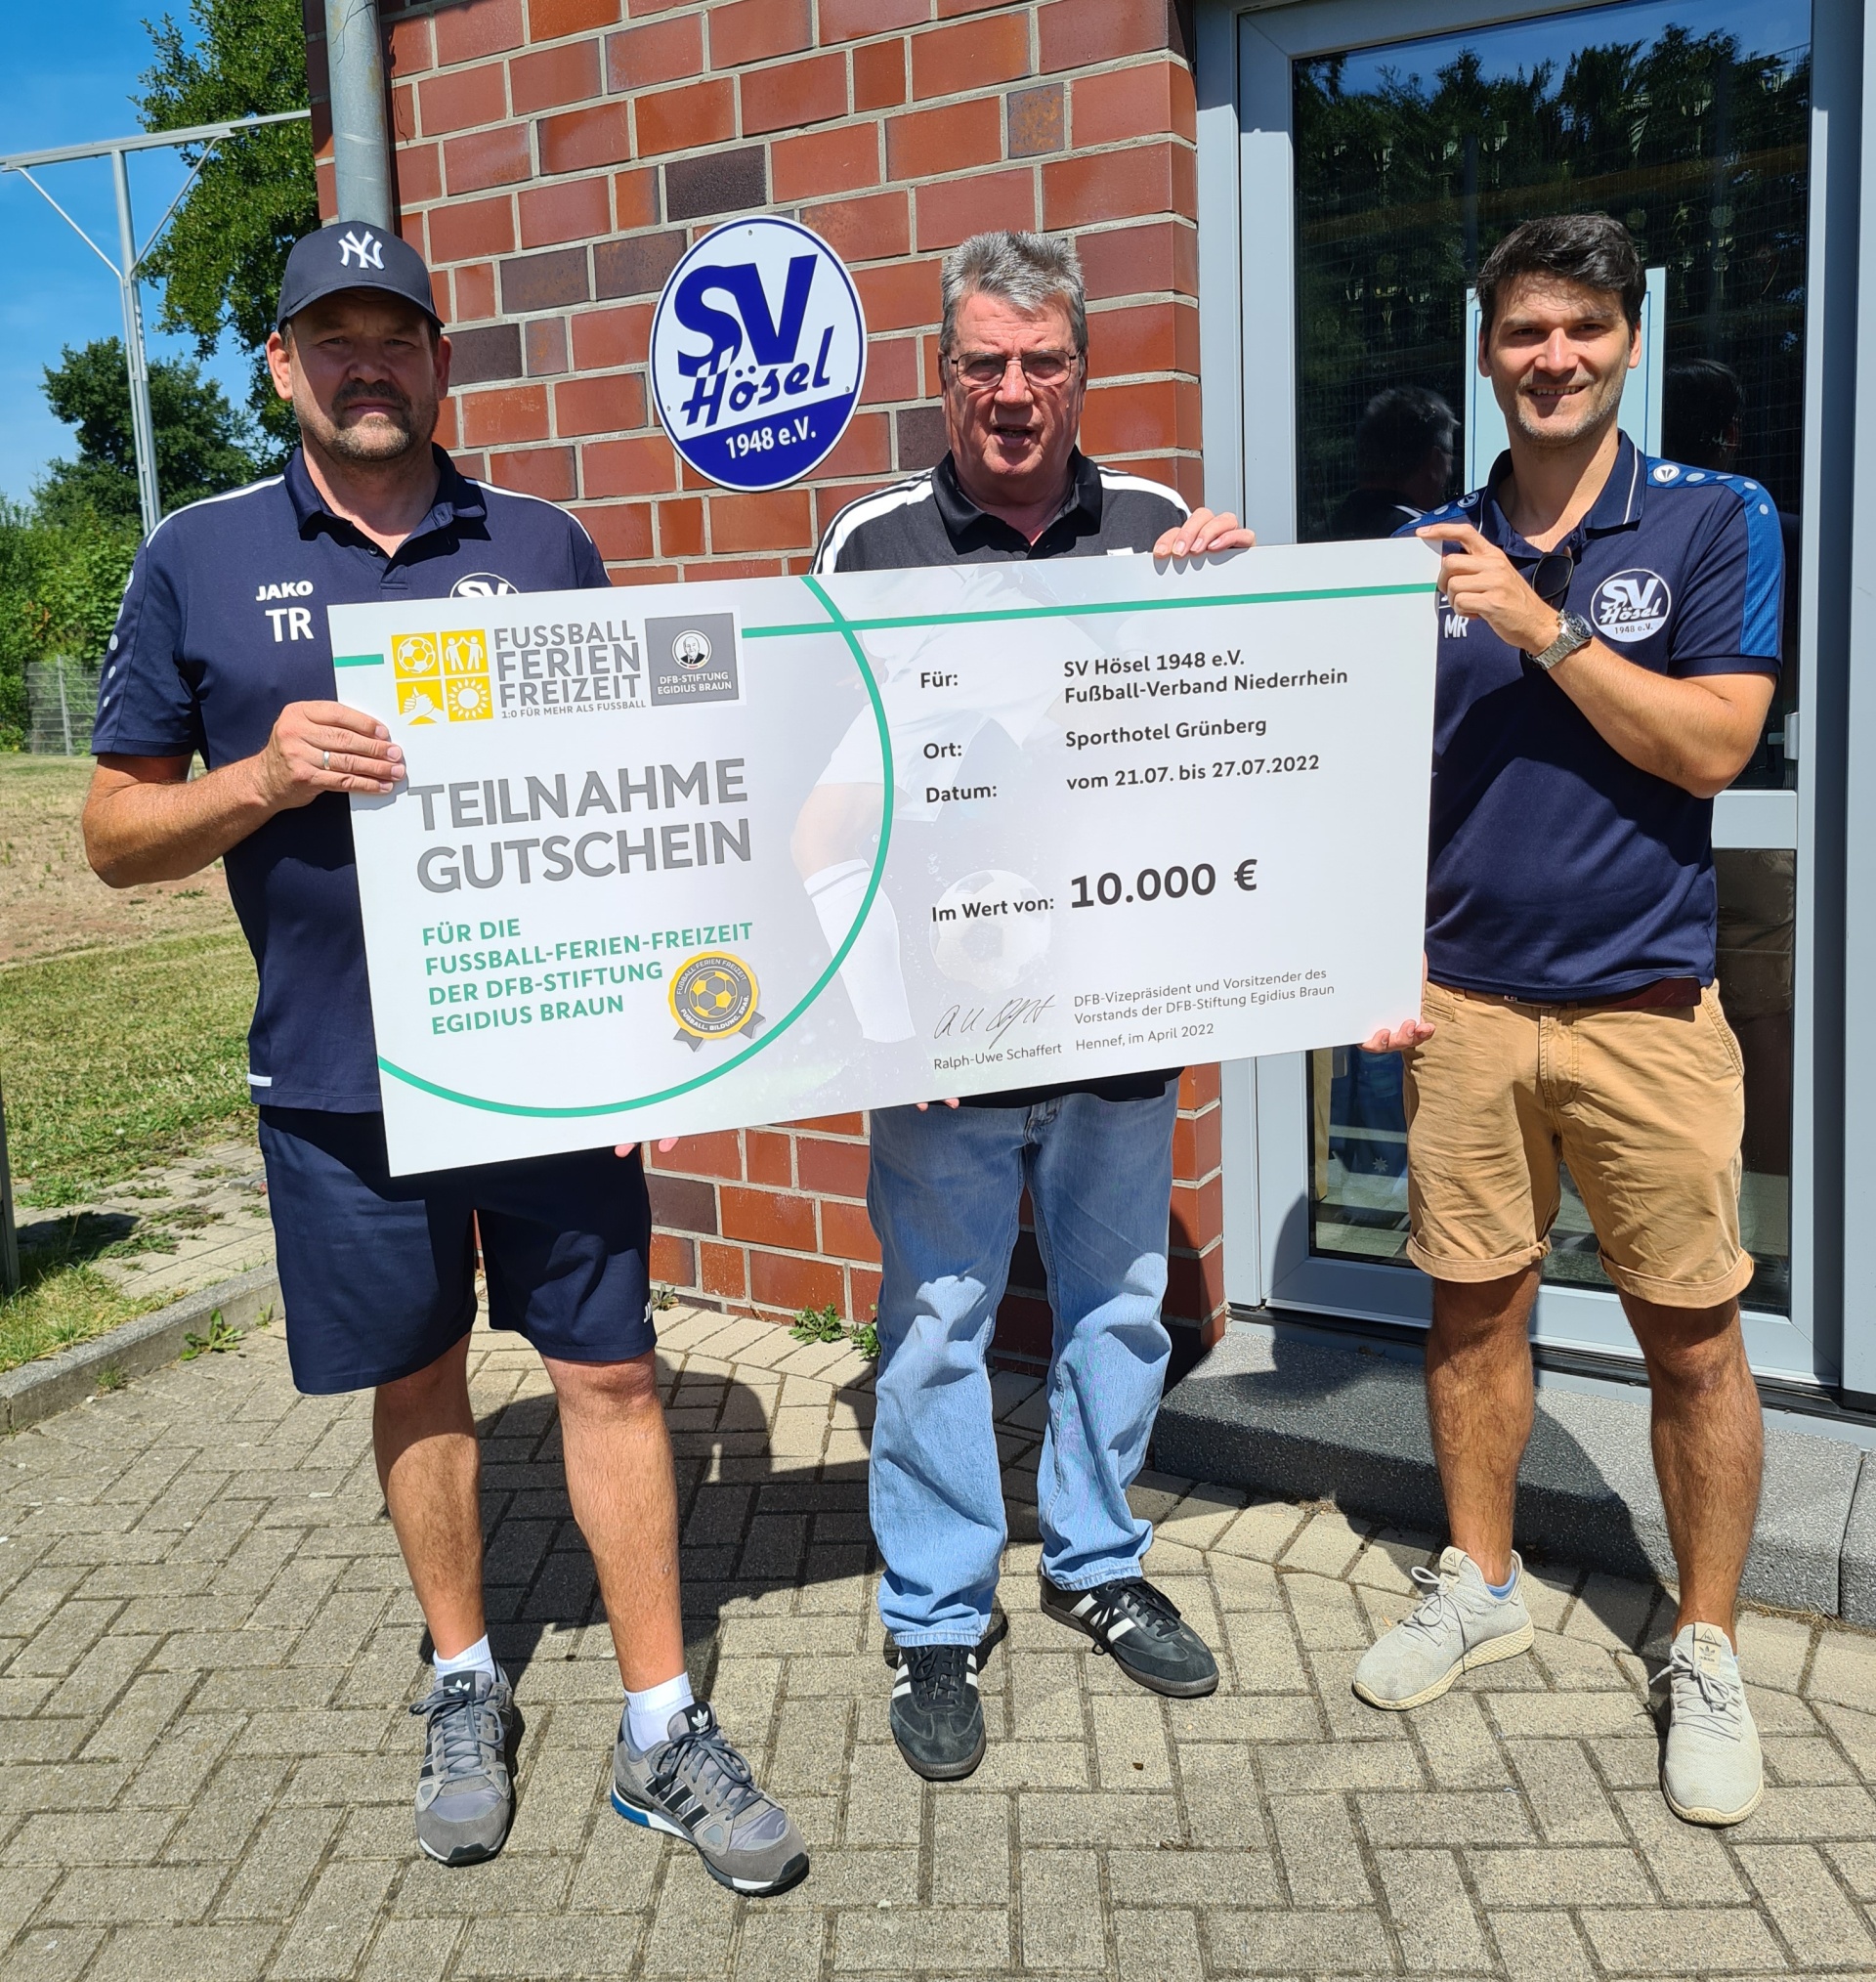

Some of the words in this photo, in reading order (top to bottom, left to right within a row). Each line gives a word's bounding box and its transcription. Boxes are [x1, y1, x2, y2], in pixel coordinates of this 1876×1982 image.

[338, 231, 385, 270] NY
[674, 254, 818, 378] SV
[680, 325, 834, 428] Hösel
[726, 427, 774, 459] 1948
[779, 416, 816, 446] e.V.
[256, 581, 314, 602] JAKO
[1600, 579, 1659, 610] SV
[266, 607, 315, 642] TR
[1444, 614, 1470, 638] MR
[1599, 597, 1662, 624] Hösel
[493, 620, 636, 650] FUSSBALL
[1614, 625, 1636, 634] 1948
[495, 642, 641, 681] FERIEN
[1063, 661, 1088, 677] SV
[1094, 656, 1151, 675] Hösel
[1156, 652, 1206, 670] 1948
[1212, 650, 1245, 667] e.V.
[499, 674, 641, 708] FREIZEIT
[657, 683, 697, 695] EGIDIUS
[699, 680, 733, 693] BRAUN
[659, 671, 729, 685] DFB-STIFTUNG
[920, 671, 959, 689] Für:
[1065, 676, 1227, 704] Fußball-Verband
[1234, 668, 1348, 691] Niederrhein
[501, 710, 518, 718] 1:0
[520, 706, 541, 718] FÜR
[543, 705, 574, 715] MEHR
[576, 703, 594, 713] ALS
[597, 700, 647, 711] FUSSBALL
[1066, 723, 1171, 751] Sporthotel
[1175, 718, 1267, 738] Grünberg
[923, 743, 962, 759] Ort:
[1066, 775, 1109, 790] vom
[1114, 766, 1173, 786] 21.07.
[1179, 764, 1206, 781] bis
[1212, 754, 1320, 778] 27.07.2022
[406, 757, 748, 831] TEILNAHME
[925, 784, 998, 803] Datum:
[416, 818, 751, 893] GUTSCHEIN
[1071, 863, 1216, 909] 10.000
[1233, 859, 1258, 891] €
[931, 905, 957, 922] Im
[961, 899, 1008, 919] Wert
[1012, 896, 1054, 913] von:
[422, 922, 472, 946] FÜR
[480, 918, 521, 940] DIE
[425, 922, 753, 976] FUSSBALL-FERIEN-FREIZEIT
[429, 981, 480, 1006] DER
[487, 961, 663, 1001] DFB-STIFTUNG
[695, 959, 721, 969] FERIEN
[721, 960, 746, 981] FREIZEIT
[1074, 984, 1192, 1008] DFB-Vizepräsident
[1195, 980, 1219, 993] und
[1222, 971, 1302, 989] Vorsitzender
[1304, 969, 1327, 981] des
[1074, 1007, 1138, 1024] Vorstands
[1141, 1004, 1163, 1017] der
[1166, 995, 1247, 1013] DFB-Stiftung
[1250, 988, 1296, 1005] Egidius
[1300, 985, 1335, 998] Braun
[432, 1006, 533, 1035] EGIDIUS
[539, 995, 624, 1021] BRAUN
[1075, 1034, 1126, 1052] Hennef,
[1128, 1032, 1144, 1045] im
[1147, 1027, 1177, 1043] April
[1180, 1022, 1215, 1037] 2022
[934, 1053, 1003, 1070] Ralph-Uwe
[1006, 1043, 1062, 1060] Schaffert
